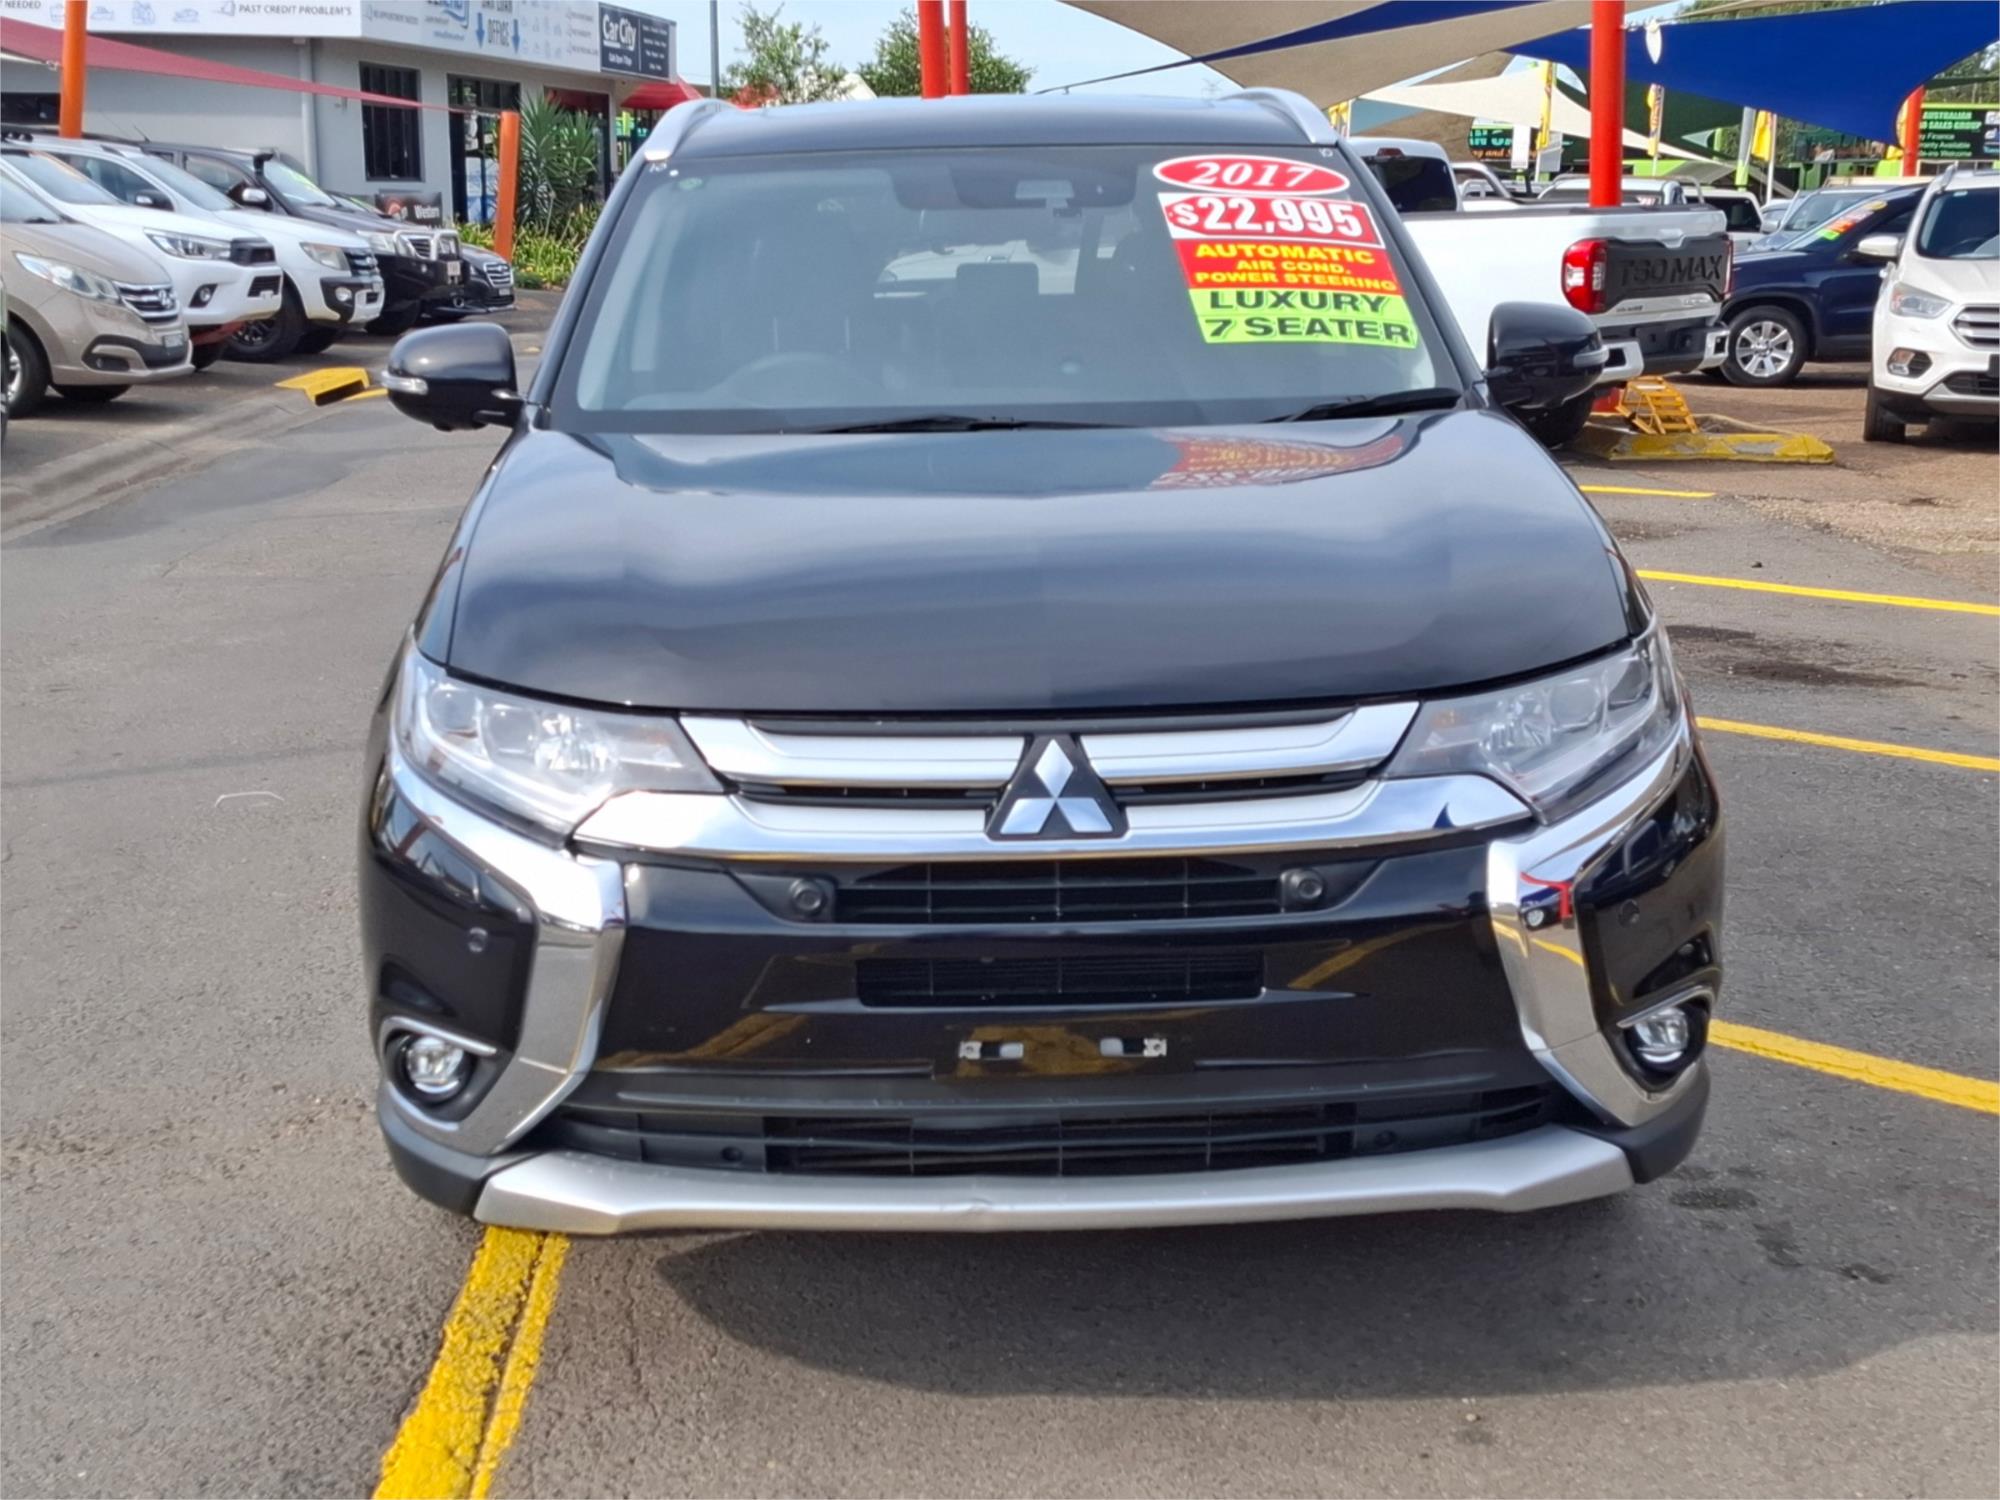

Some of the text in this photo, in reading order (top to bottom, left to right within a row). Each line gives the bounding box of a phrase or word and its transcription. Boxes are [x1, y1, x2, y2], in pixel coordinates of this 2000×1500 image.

[5, 0, 41, 9] NEEDED
[239, 4, 261, 13] PAST
[263, 5, 296, 14] CREDIT
[1187, 162, 1315, 187] 2017
[1173, 196, 1364, 238] $22,995
[1195, 243, 1376, 264] AUTOMATIC
[1236, 259, 1352, 274] AIR COND.
[1669, 254, 1722, 283] MAX
[1195, 272, 1398, 292] POWER STEERING
[1209, 290, 1390, 313] LUXURY
[1205, 317, 1411, 342] 7 SEATER
